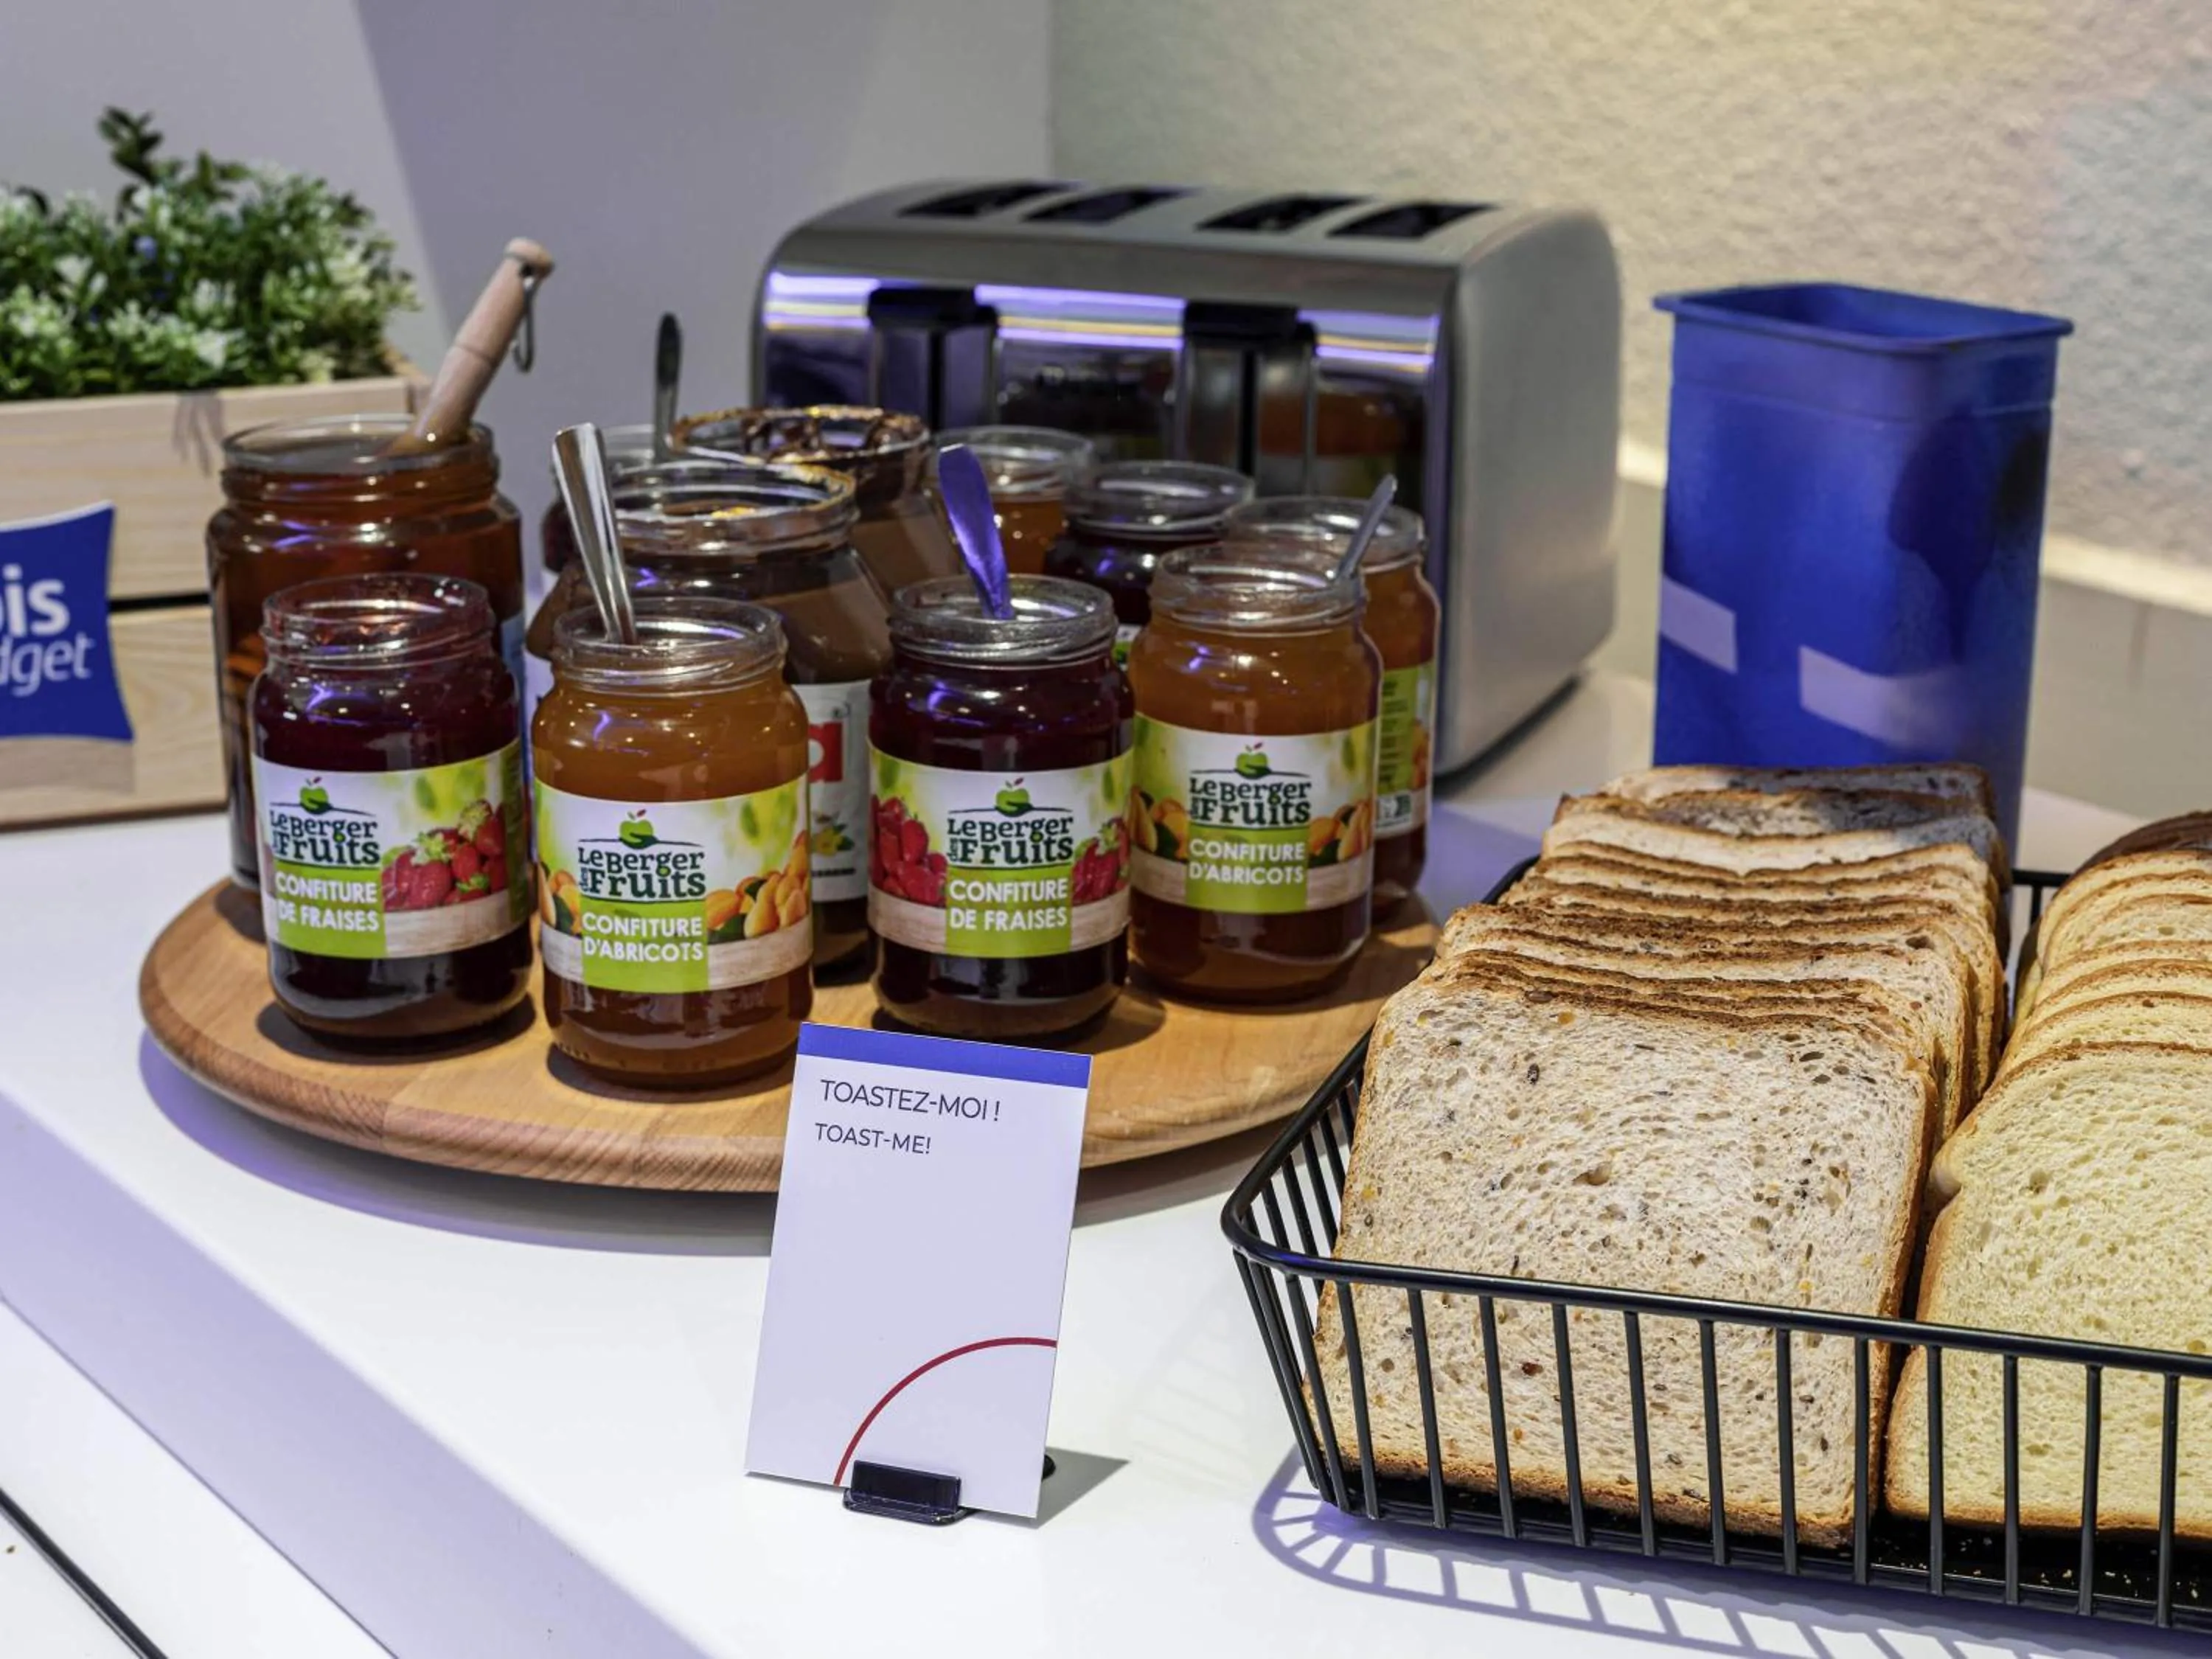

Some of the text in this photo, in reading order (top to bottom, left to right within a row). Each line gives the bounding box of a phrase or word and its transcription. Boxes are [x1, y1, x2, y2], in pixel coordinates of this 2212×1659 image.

[0, 564, 70, 636] is
[1220, 782, 1312, 805] Berger
[1200, 799, 1311, 825] Fruits
[290, 816, 378, 843] Berger
[947, 817, 1074, 843] Le Berger
[276, 832, 380, 865] Fruits
[578, 847, 705, 877] Le Berger
[960, 836, 1074, 865] Fruits
[1189, 839, 1305, 861] CONFITURE
[589, 868, 706, 898] Fruits
[1189, 862, 1304, 884] D'ABRICOTS
[274, 872, 378, 903] CONFITURE
[950, 879, 1068, 902] CONFITURE
[278, 900, 380, 932] DE FRAISES
[582, 913, 702, 937] CONFITURE
[950, 908, 1067, 931] DE FRAISES
[583, 936, 703, 962] D'ABRICOTS
[820, 1079, 988, 1121] TOASTEZ-MOI
[815, 1122, 931, 1155] TOAST-ME!
